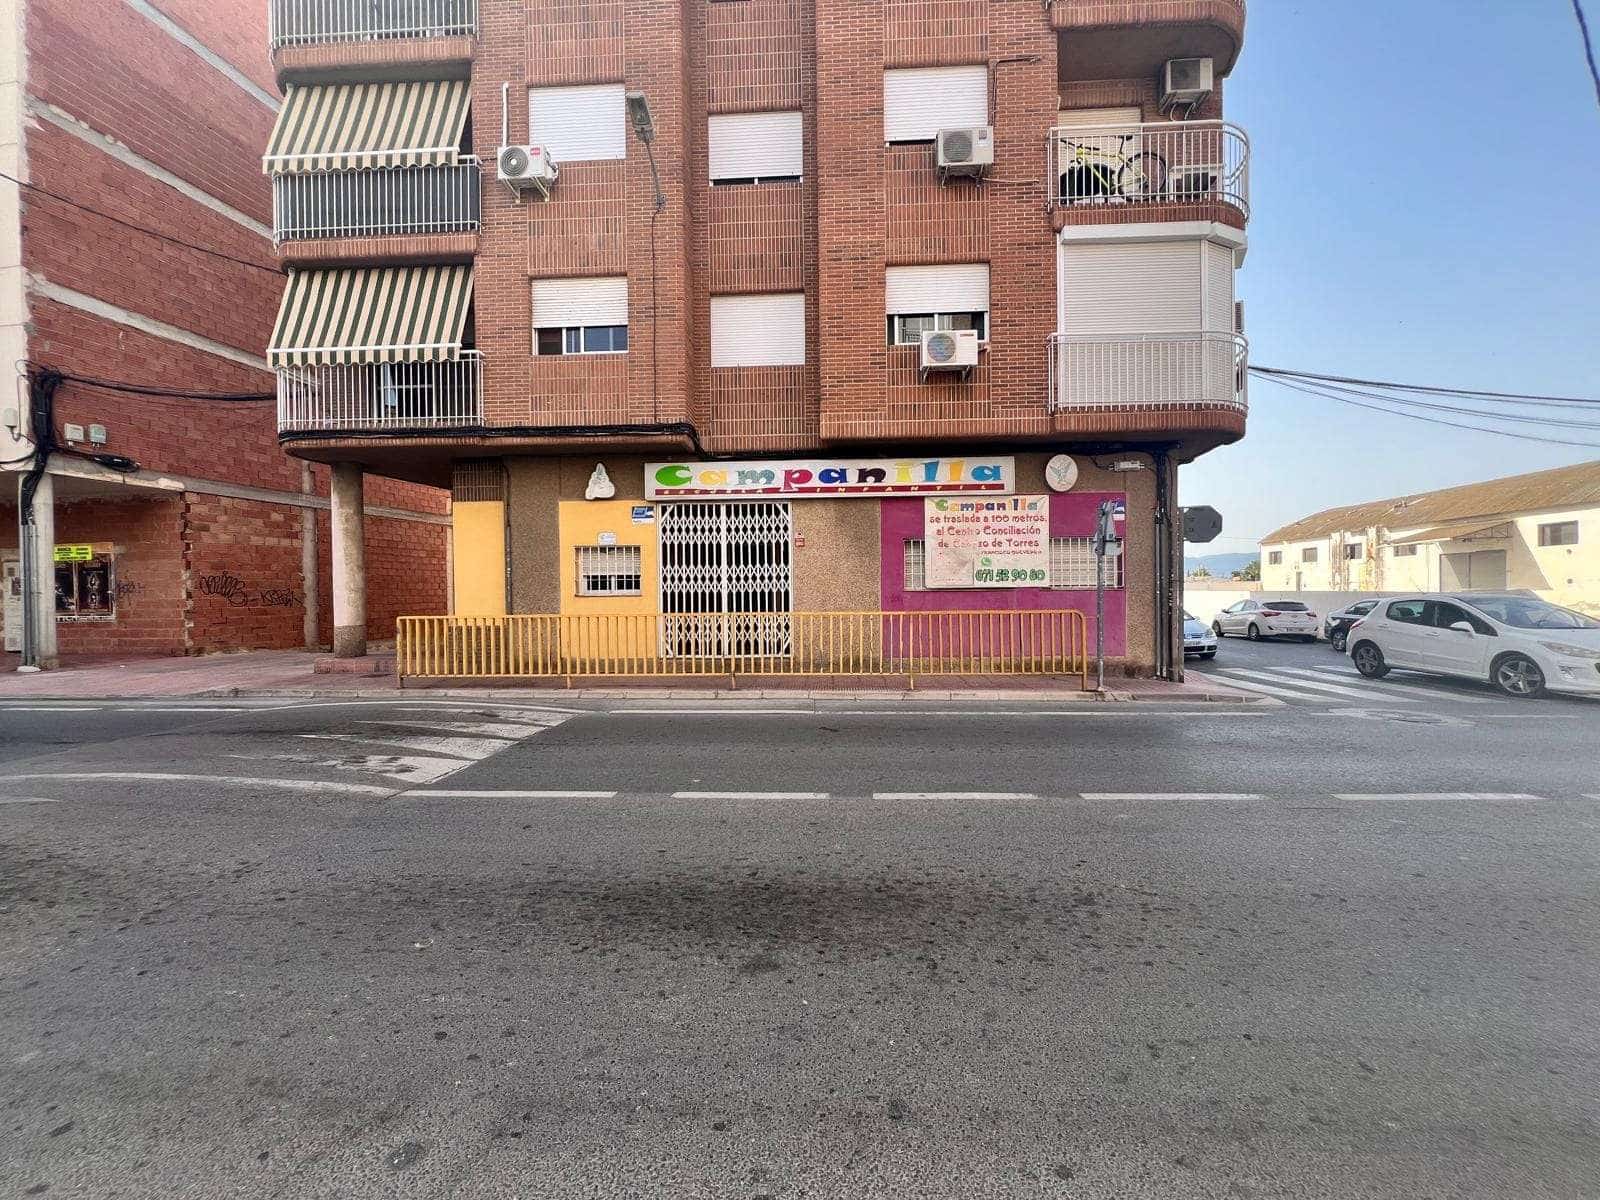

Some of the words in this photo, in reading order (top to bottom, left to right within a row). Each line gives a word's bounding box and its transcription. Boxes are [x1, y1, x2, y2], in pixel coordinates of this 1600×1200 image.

[655, 460, 1003, 492] Campanilla
[815, 484, 987, 493] INFANTIL
[935, 498, 1038, 513] Campanilla
[929, 515, 941, 524] se
[944, 514, 981, 524] traslada
[983, 515, 989, 523] a
[991, 514, 1010, 523] 100
[983, 525, 1041, 536] Conciliación
[992, 539, 1003, 548] de
[1006, 538, 1040, 548] Torres
